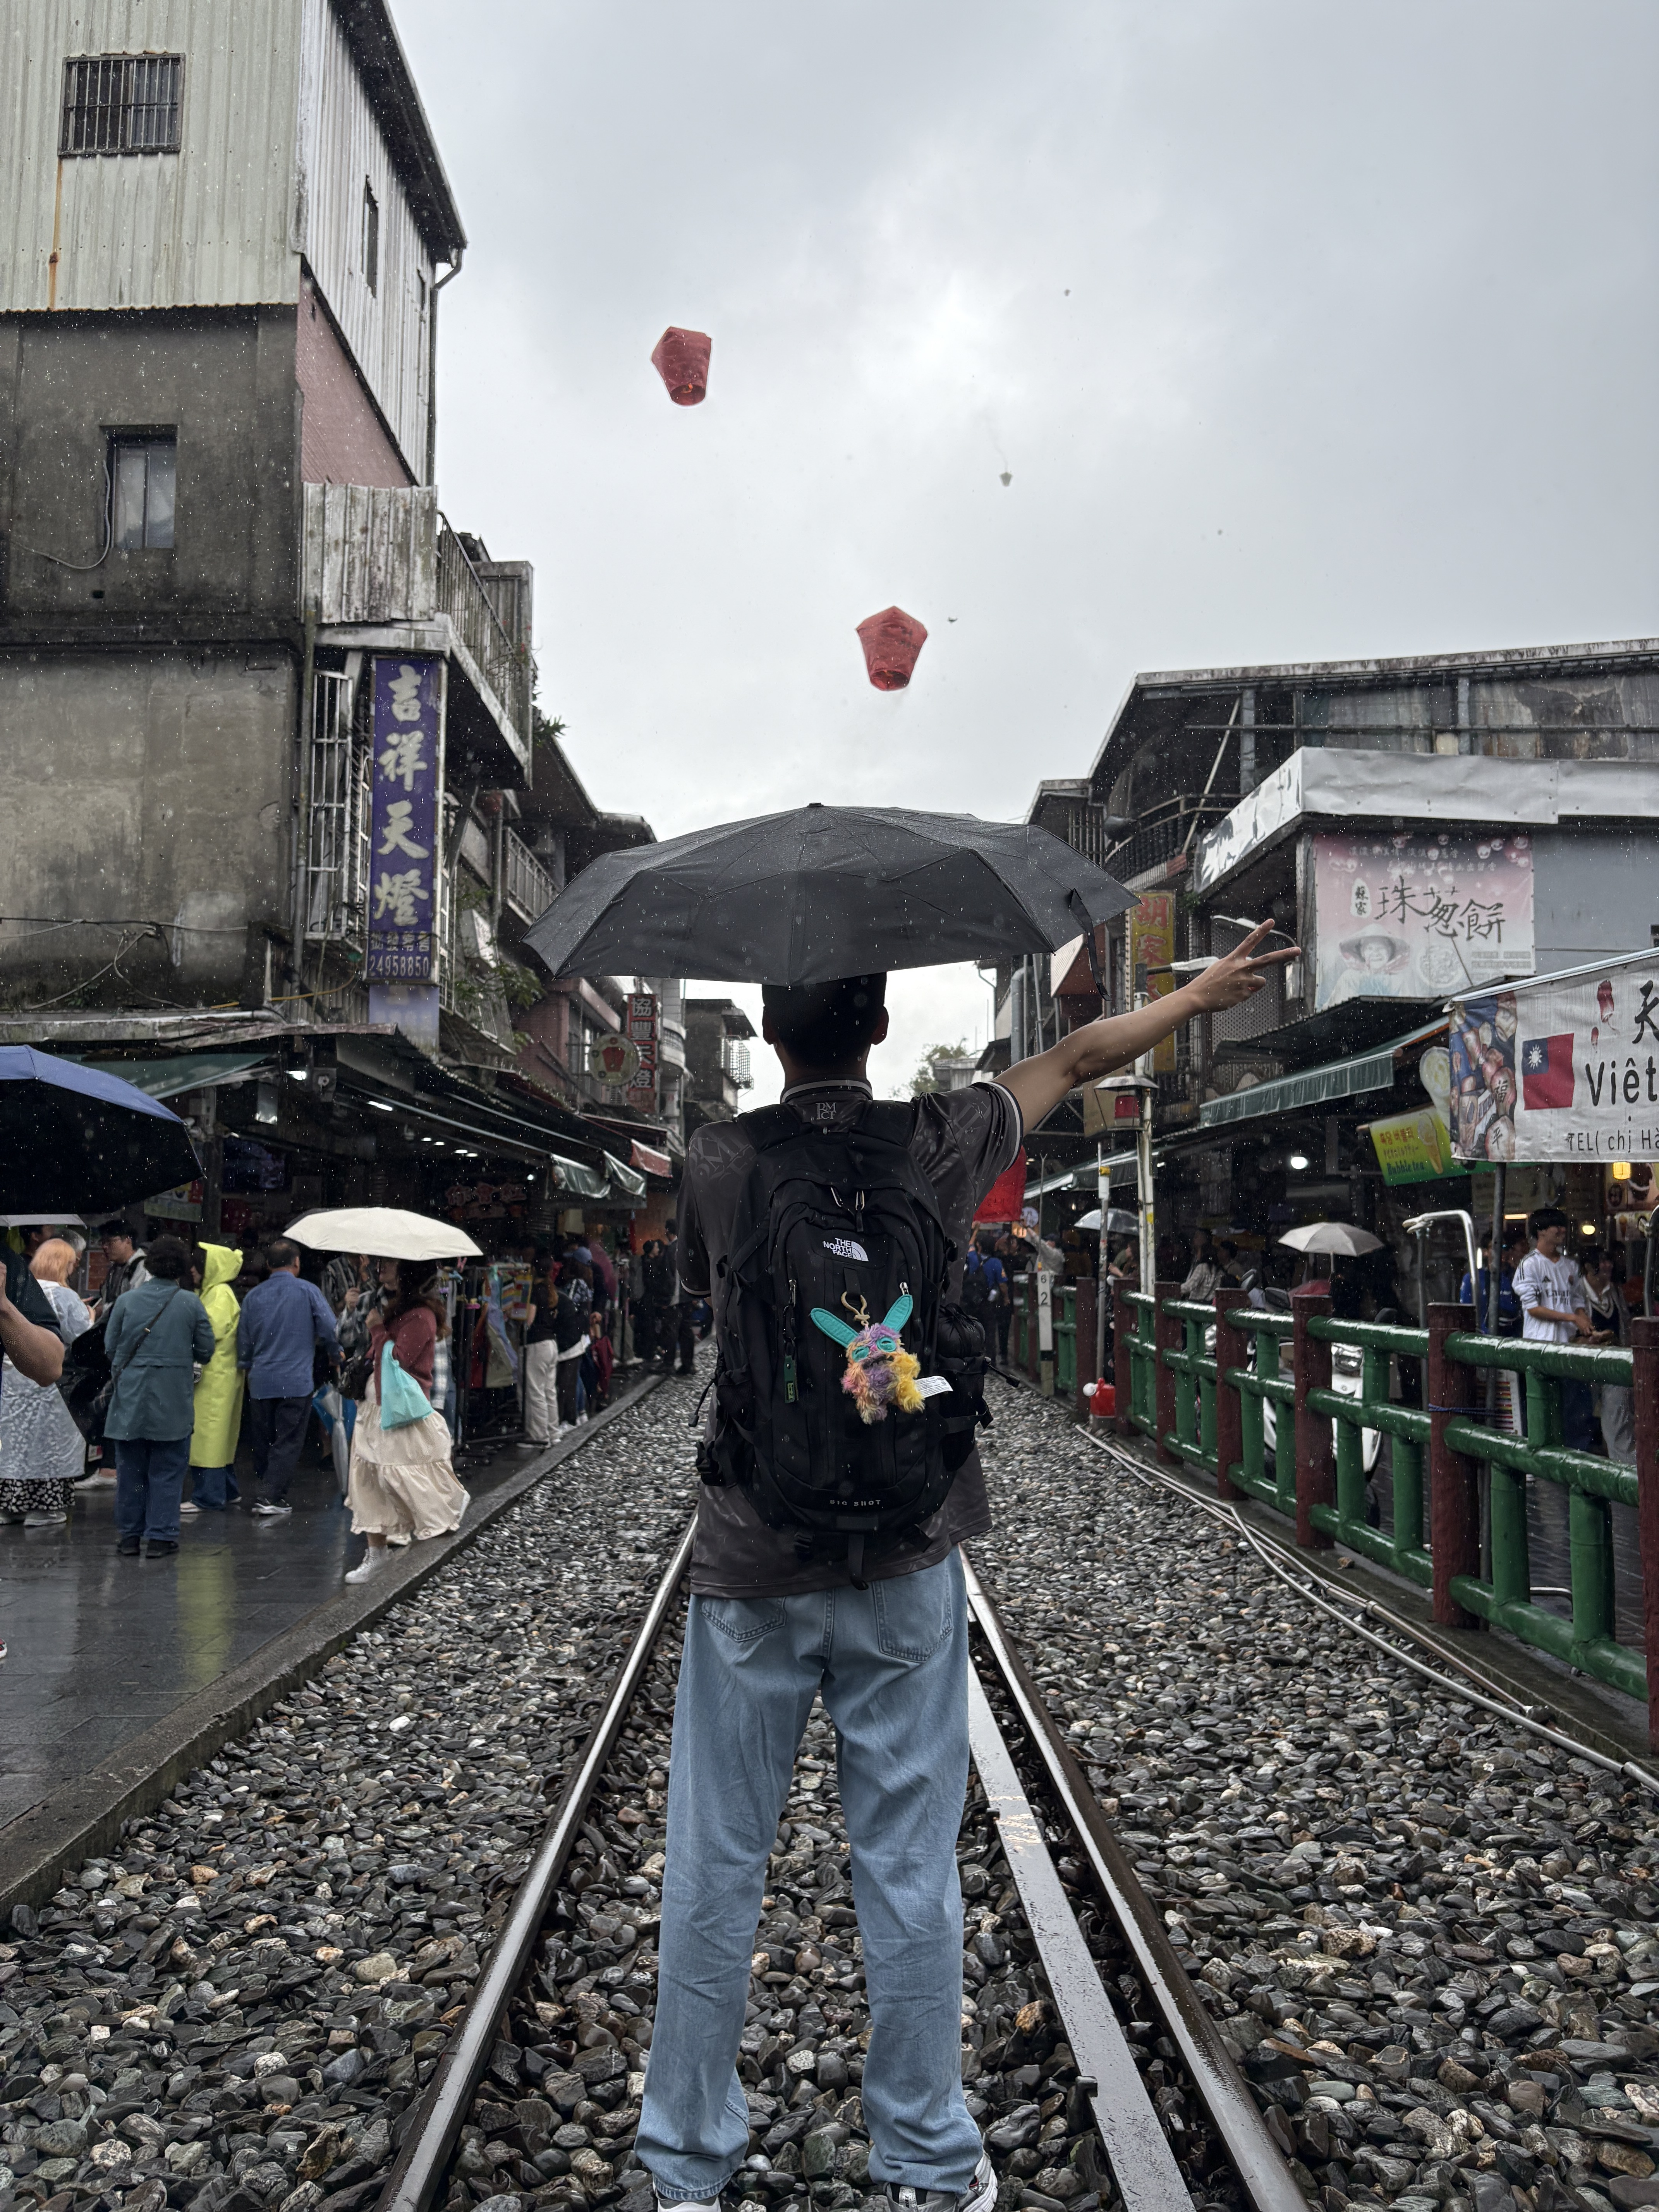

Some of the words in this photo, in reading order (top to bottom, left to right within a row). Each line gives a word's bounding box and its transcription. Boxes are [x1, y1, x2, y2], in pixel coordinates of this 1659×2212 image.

[374, 665, 429, 926] 吉祥天燈
[369, 955, 429, 976] 24958850
[1387, 1160, 1411, 1176] Bubble
[823, 1241, 852, 1254] NORTH
[835, 1238, 851, 1247] THE
[833, 1249, 853, 1259] FACE
[1041, 1291, 1048, 1305] 2
